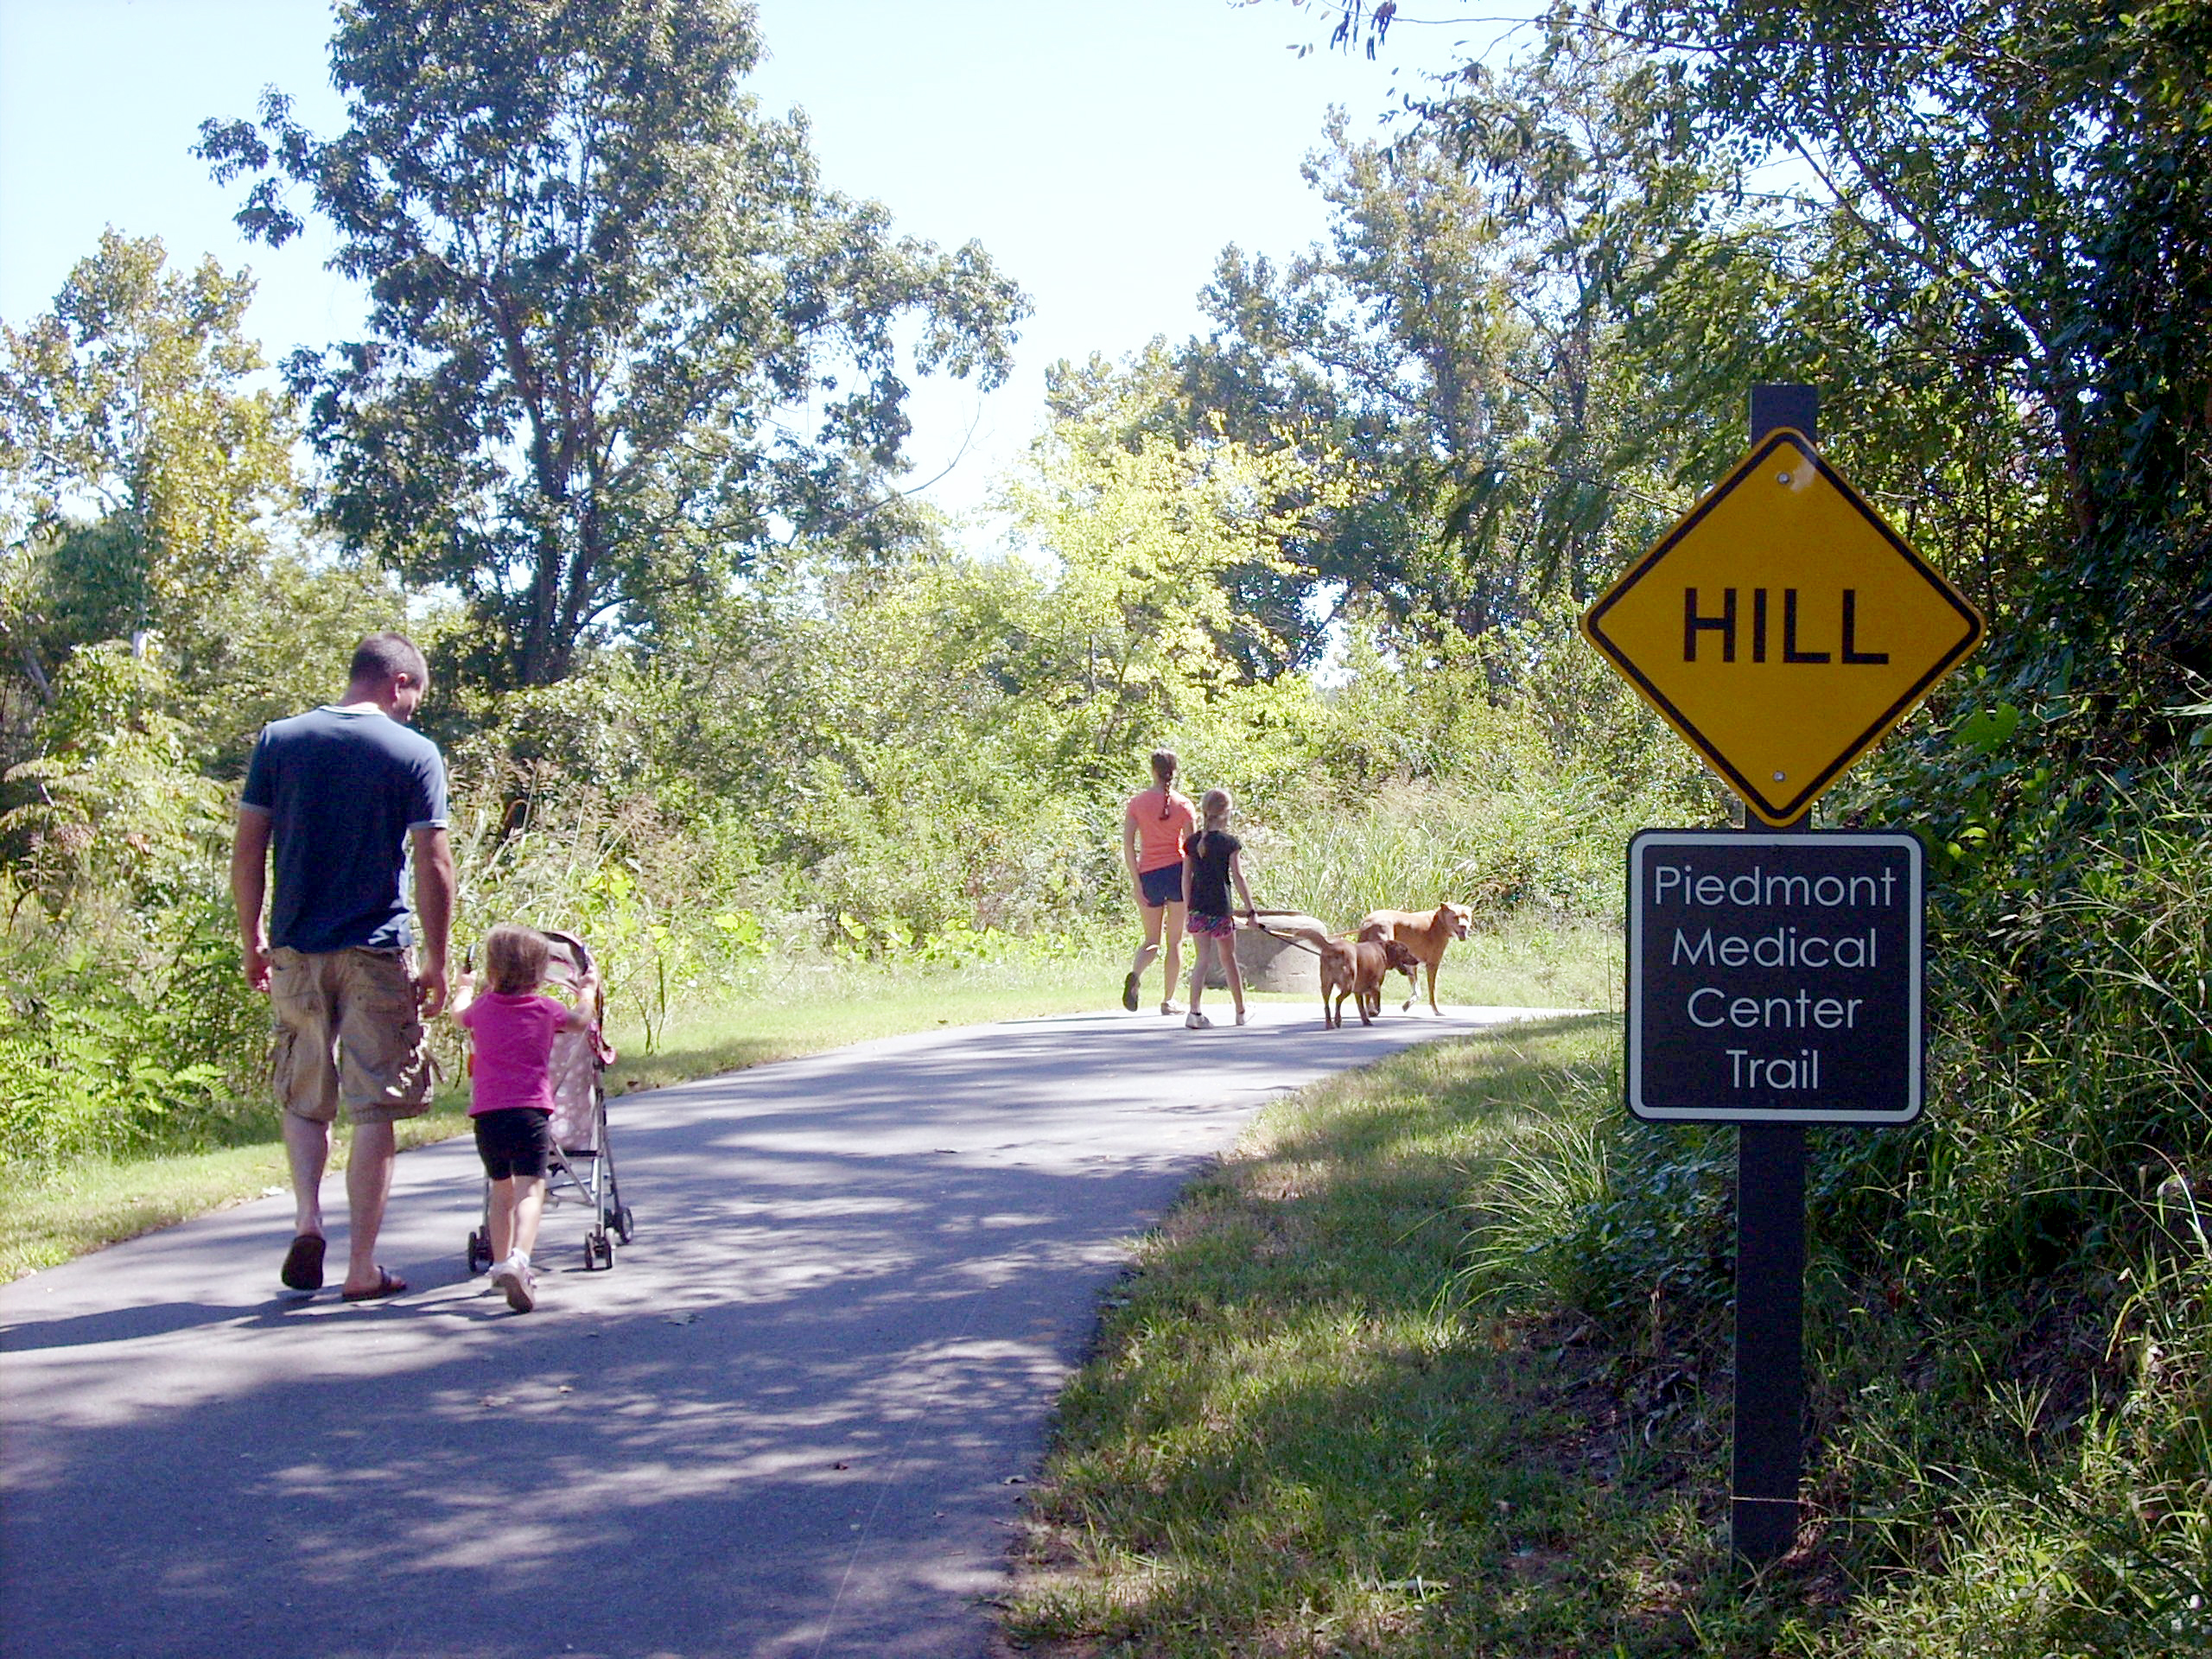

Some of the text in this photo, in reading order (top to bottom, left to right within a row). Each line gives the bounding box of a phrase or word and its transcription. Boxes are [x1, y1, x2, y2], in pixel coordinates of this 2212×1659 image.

[1683, 587, 1890, 665] HILL
[1656, 864, 1897, 906] Piedmont
[1671, 926, 1876, 968] Medical
[1687, 987, 1863, 1029] Center
[1726, 1048, 1819, 1090] Trail
